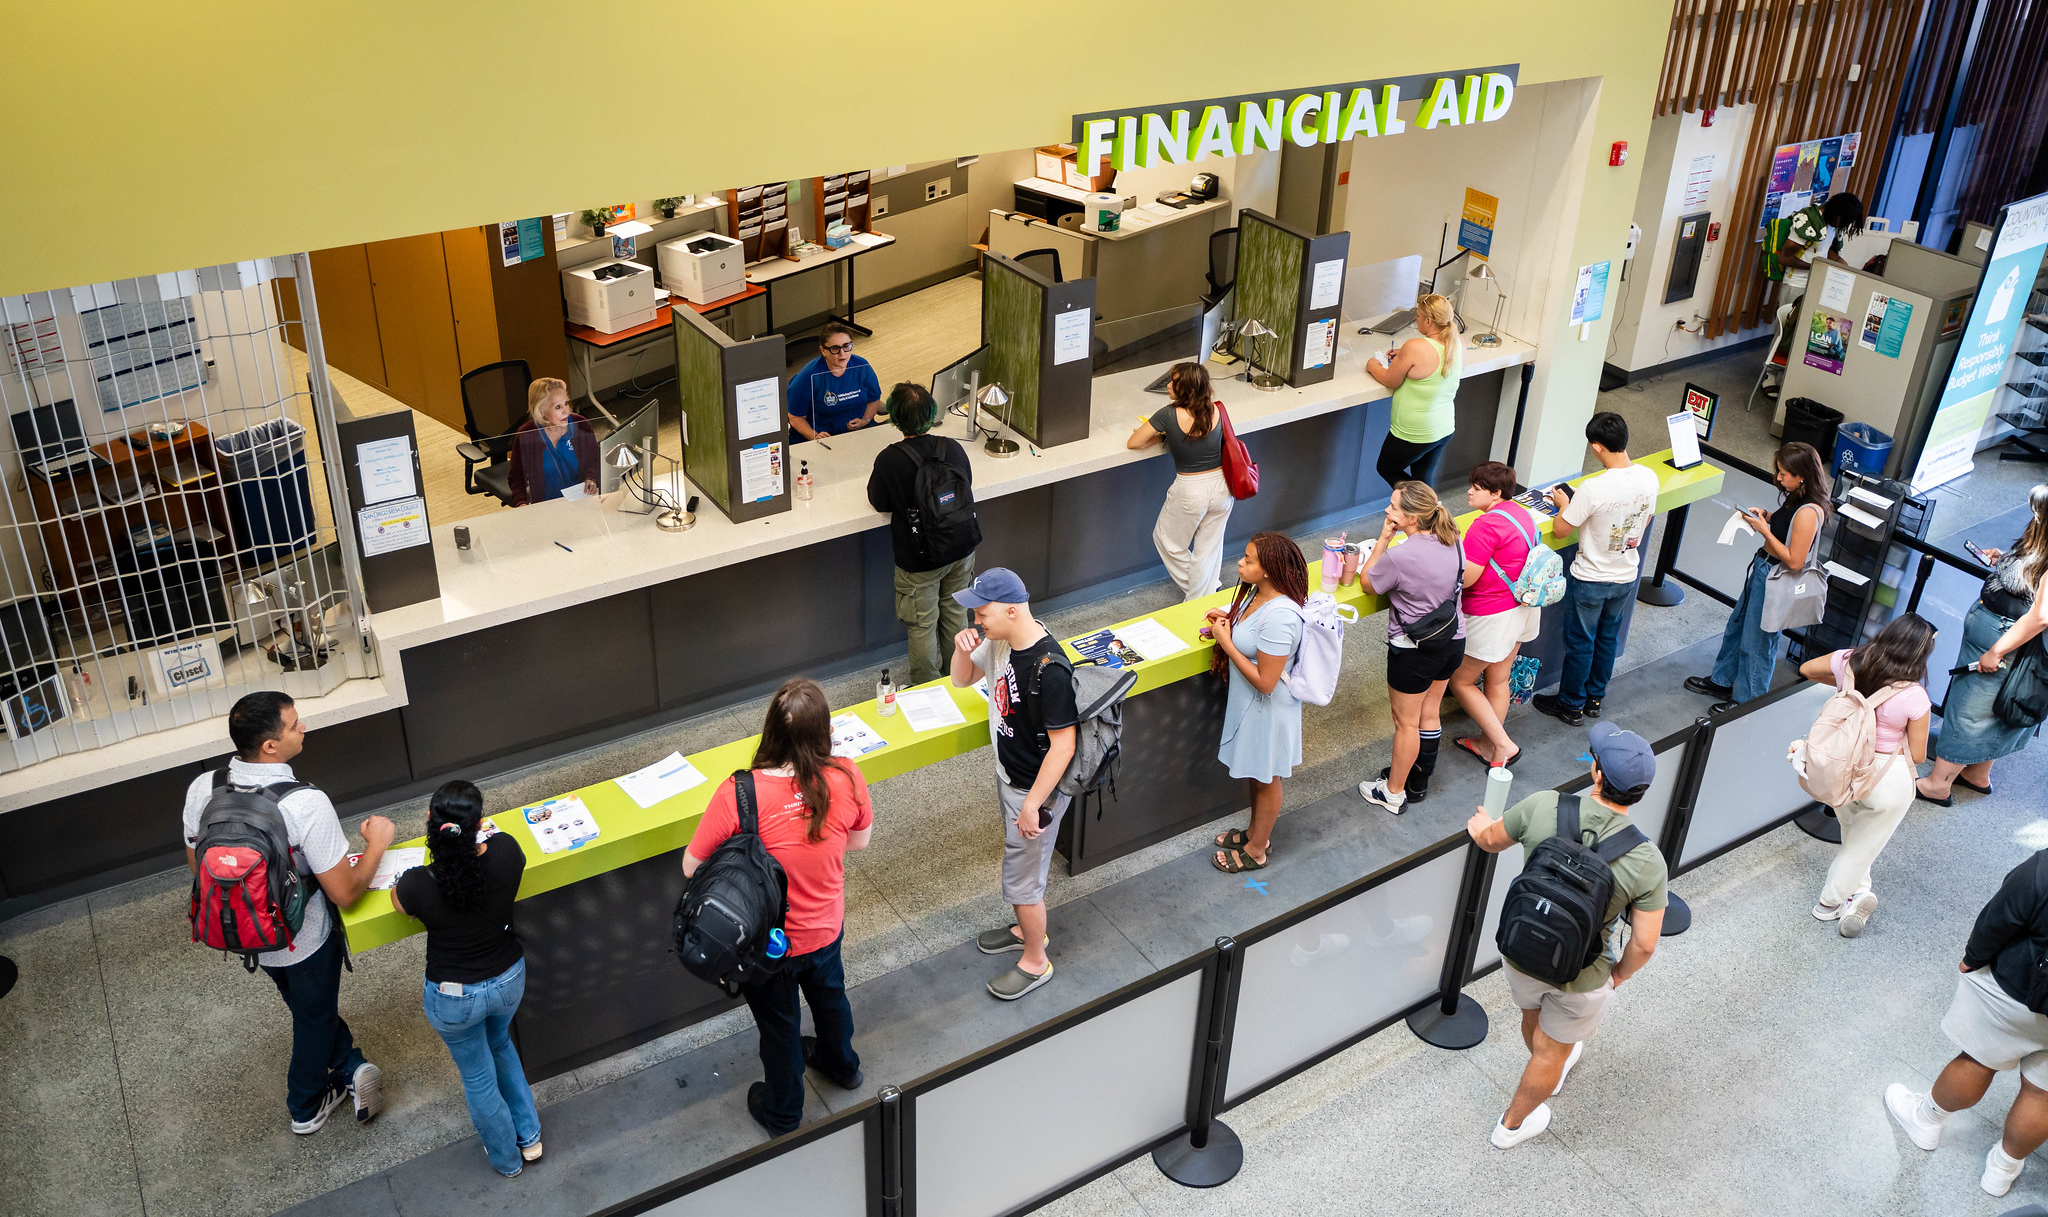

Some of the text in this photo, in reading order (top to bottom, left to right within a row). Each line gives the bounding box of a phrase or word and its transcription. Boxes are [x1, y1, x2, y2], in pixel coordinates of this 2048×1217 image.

[1078, 72, 1513, 176] FINANCIAL AID
[1815, 333, 1832, 344] CAN
[1978, 328, 2001, 348] Think
[1957, 342, 2006, 372] Responsibly.
[1946, 359, 2004, 391] Budget Wisely.
[1687, 390, 1708, 411] EXIT
[373, 509, 388, 518] DIEGO
[400, 503, 419, 512] COLLEGE
[164, 645, 193, 655] WINOW
[783, 801, 805, 810] THRIV
